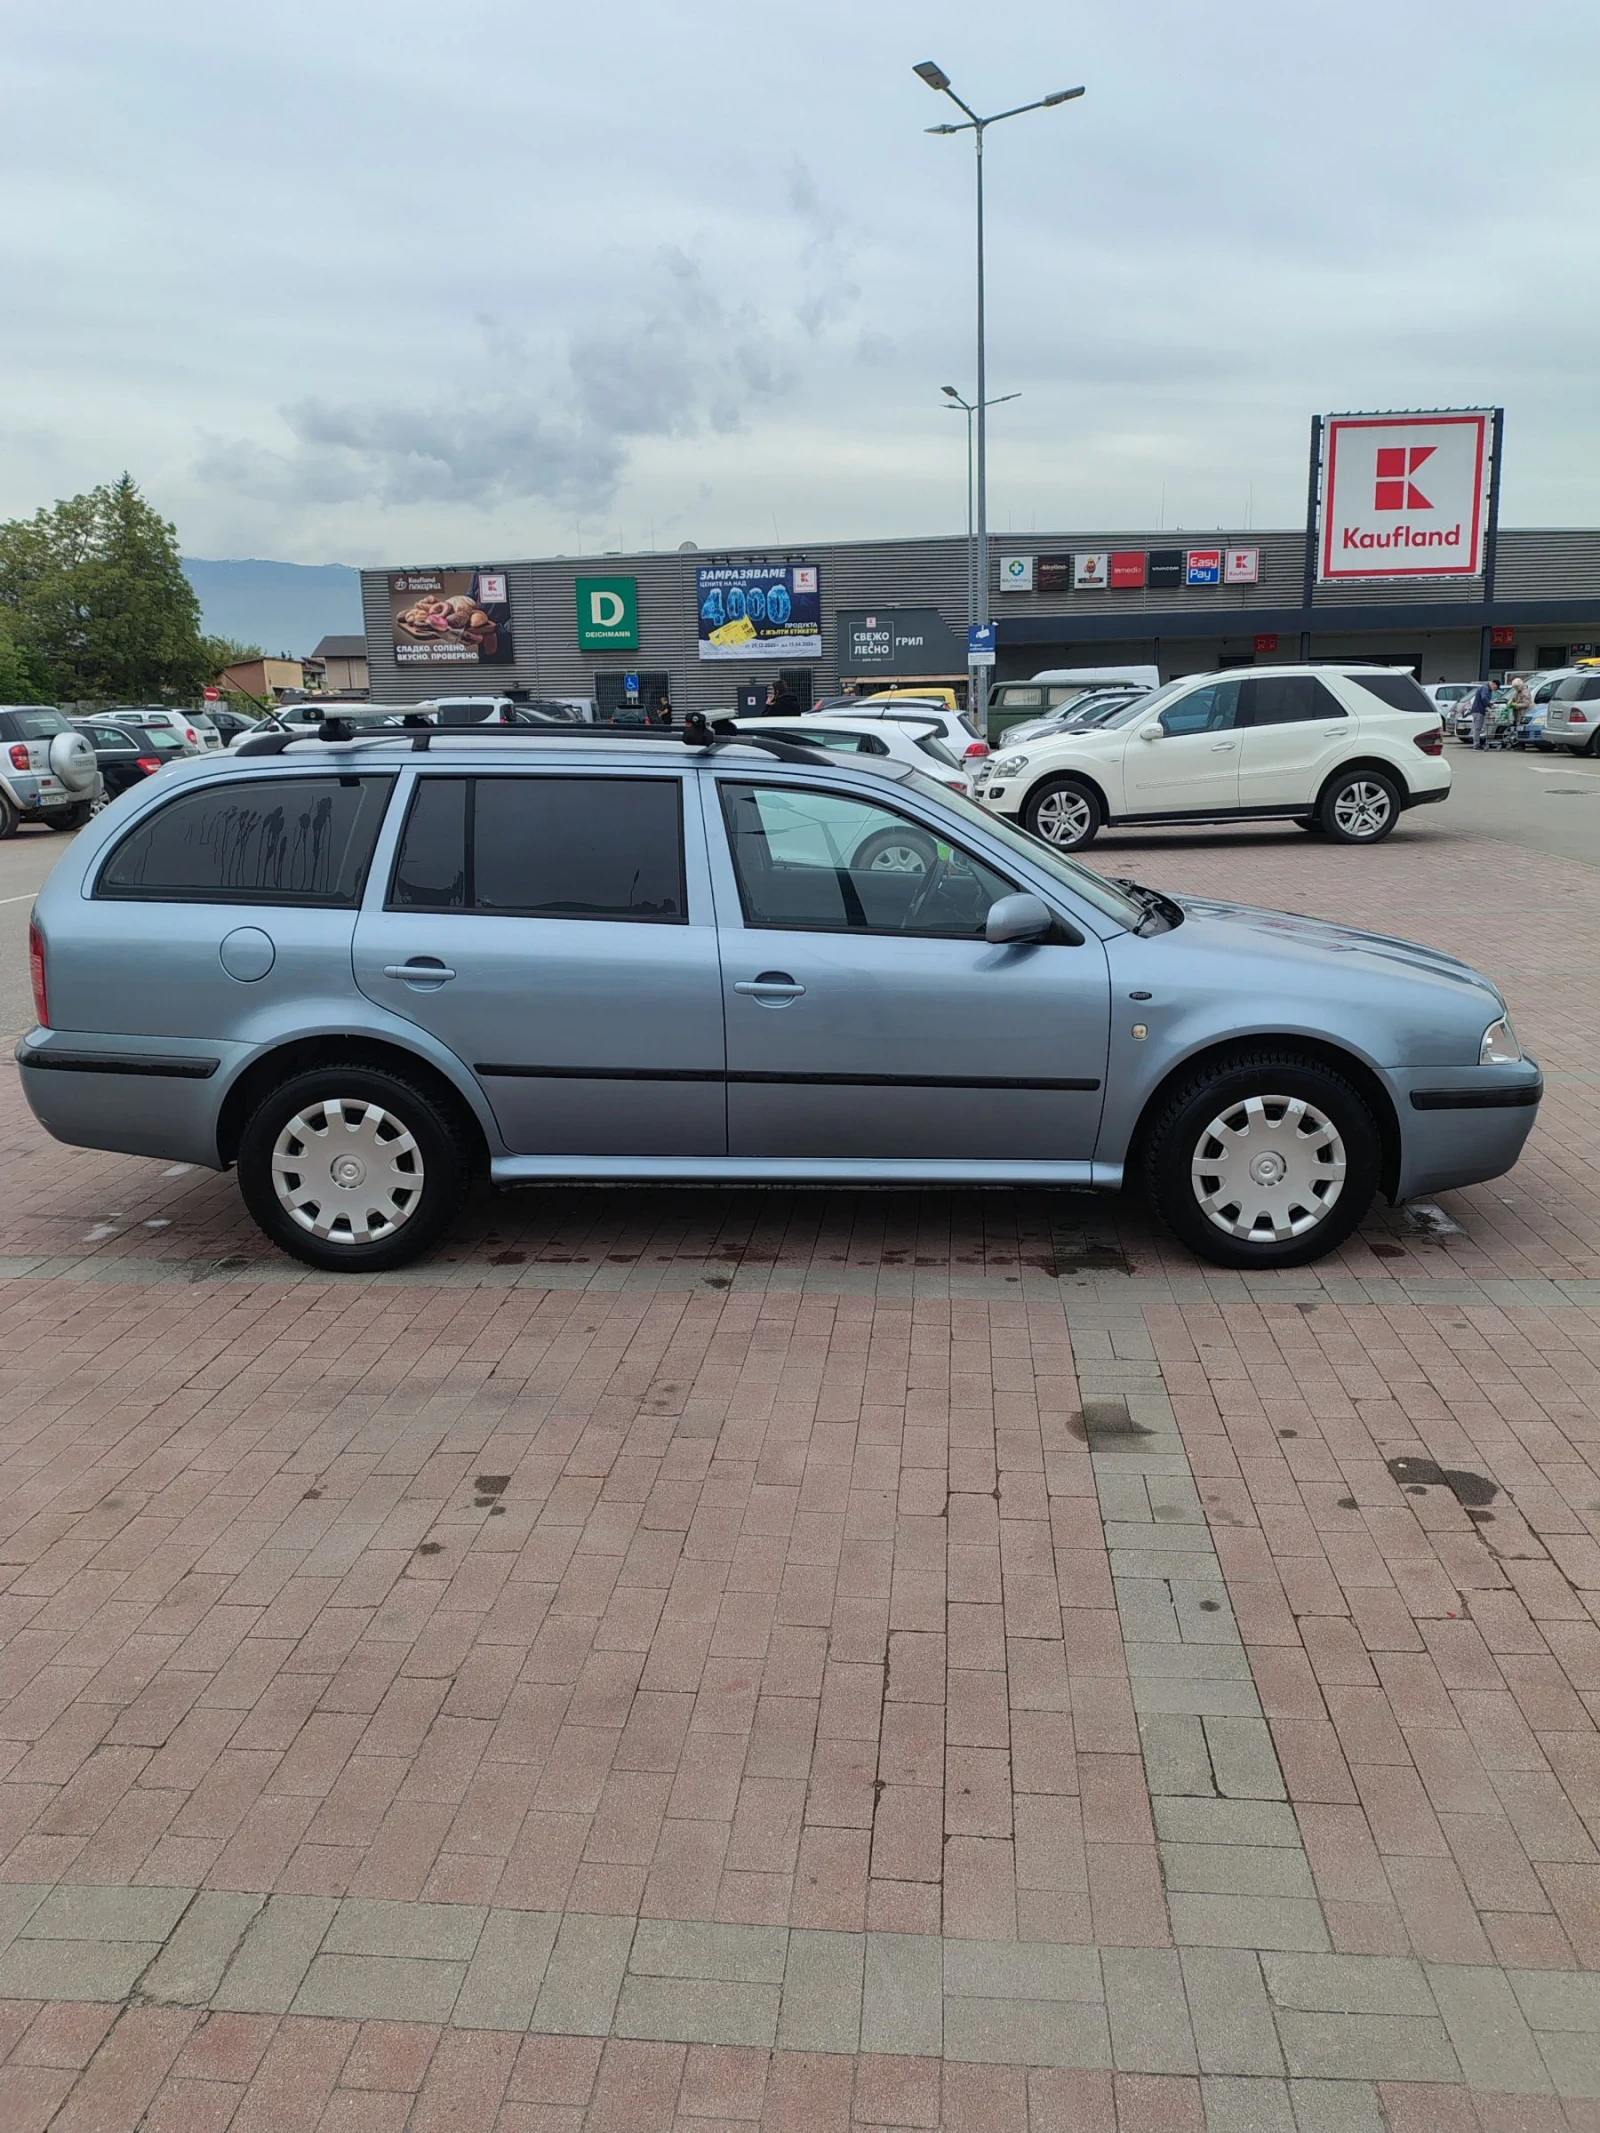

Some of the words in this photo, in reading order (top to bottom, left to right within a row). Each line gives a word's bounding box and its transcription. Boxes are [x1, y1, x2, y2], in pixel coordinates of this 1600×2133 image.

[1343, 524, 1460, 549] Kaufland
[1190, 557, 1218, 569] Easy
[700, 569, 786, 580] ЗАМРАЗЯВАМЕ
[1190, 569, 1211, 580] Pay
[408, 576, 435, 584] Kaufland
[408, 583, 442, 591] пекарна
[591, 591, 625, 627] D
[701, 584, 791, 626] 4000
[853, 632, 890, 641] СВЕЖО
[895, 637, 923, 646] ГРИЛ
[396, 645, 432, 653] СЛАДКО.
[433, 644, 467, 652] СОЛЕНО.
[854, 645, 889, 654] ЛЕСНО
[431, 652, 479, 660] ПРОВЕРЕНО.
